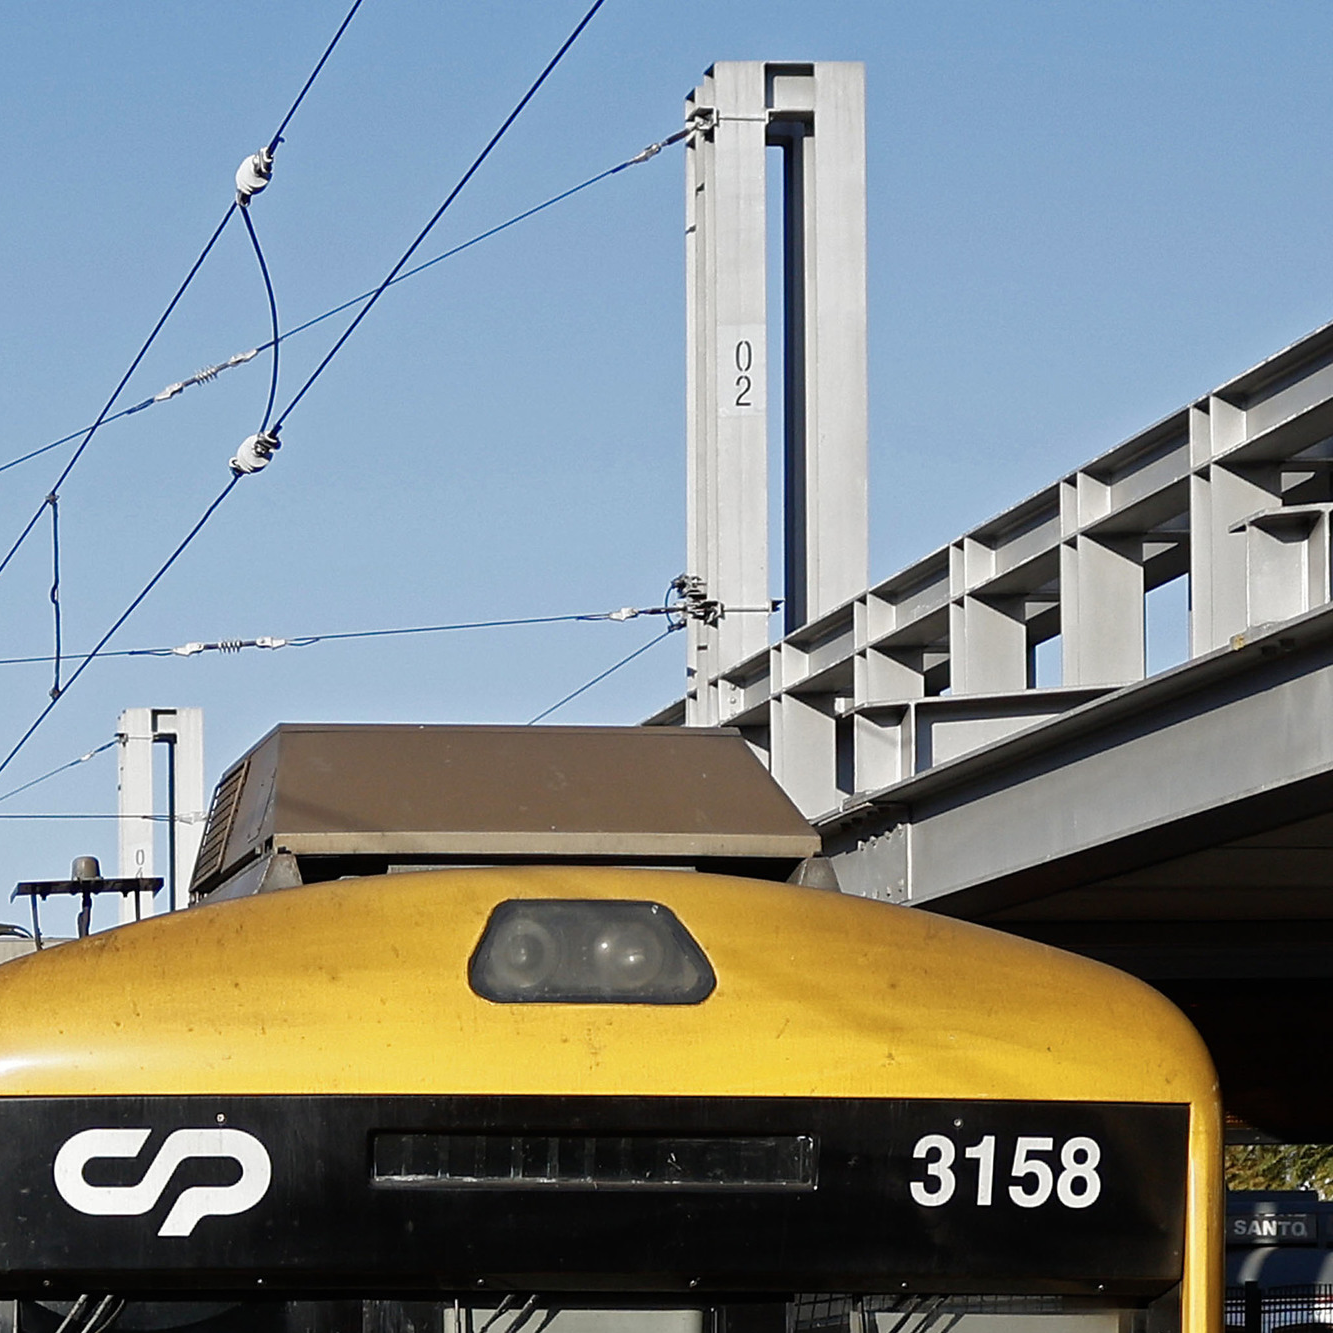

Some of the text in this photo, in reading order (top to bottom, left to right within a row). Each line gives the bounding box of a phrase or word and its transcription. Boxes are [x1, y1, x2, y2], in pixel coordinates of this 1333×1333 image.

[735, 340, 752, 406] 02
[53, 1128, 272, 1237] CP
[909, 1134, 1102, 1209] 3158
